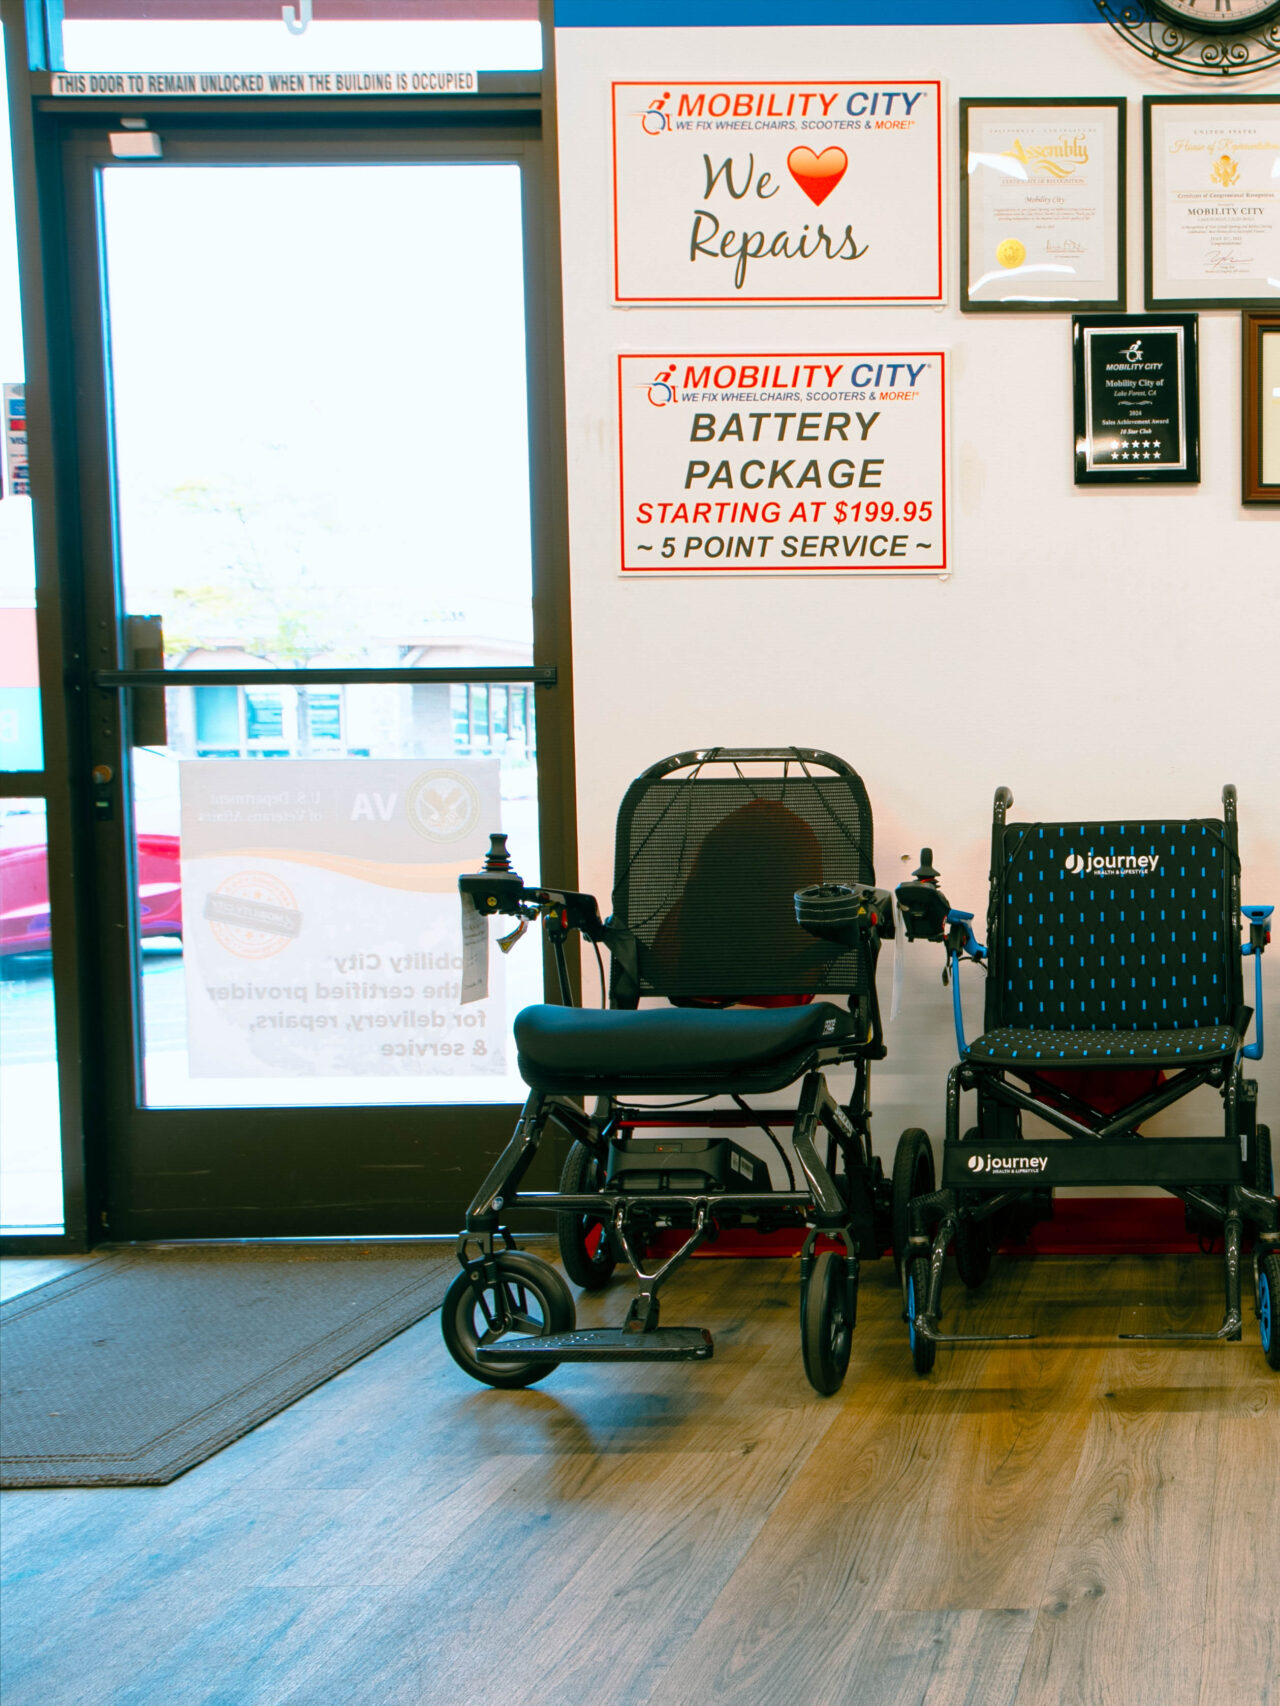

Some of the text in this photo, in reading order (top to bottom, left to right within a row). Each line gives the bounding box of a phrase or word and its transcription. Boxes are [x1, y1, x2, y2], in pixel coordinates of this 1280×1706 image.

[57, 73, 474, 93] THIS DOOR TO REMAIN UNLOCKED WHEN THE BUILDING IS OCCUPIED
[677, 92, 922, 117] MOBILITY CITY
[676, 121, 693, 131] WE
[696, 121, 713, 131] FIX
[715, 121, 798, 131] WHEELCHAIRS,
[801, 120, 861, 131] SCOOTERS
[864, 120, 872, 130] &
[1000, 133, 1089, 165] Assembly
[702, 152, 780, 200] We
[1187, 207, 1265, 216] MOBILITY CITY
[690, 209, 869, 289] Repairs
[683, 363, 927, 389] MOBILITY CITY
[1106, 363, 1144, 371] MOBILITY
[1106, 379, 1137, 388] Mobility
[1138, 379, 1154, 388] City
[682, 393, 699, 402] WE
[701, 393, 719, 402] FIX
[721, 392, 803, 402] WHEELCHAIRS,
[806, 391, 866, 401] SCOOTERS
[869, 392, 877, 401] &
[690, 411, 881, 442] BATTERY
[684, 458, 884, 489] PACKAGE
[636, 500, 933, 525] STARTING AT $199.95
[661, 535, 909, 558] 5 POINT SERVICE
[1085, 852, 1160, 873] journey
[985, 1154, 1048, 1172] journey
